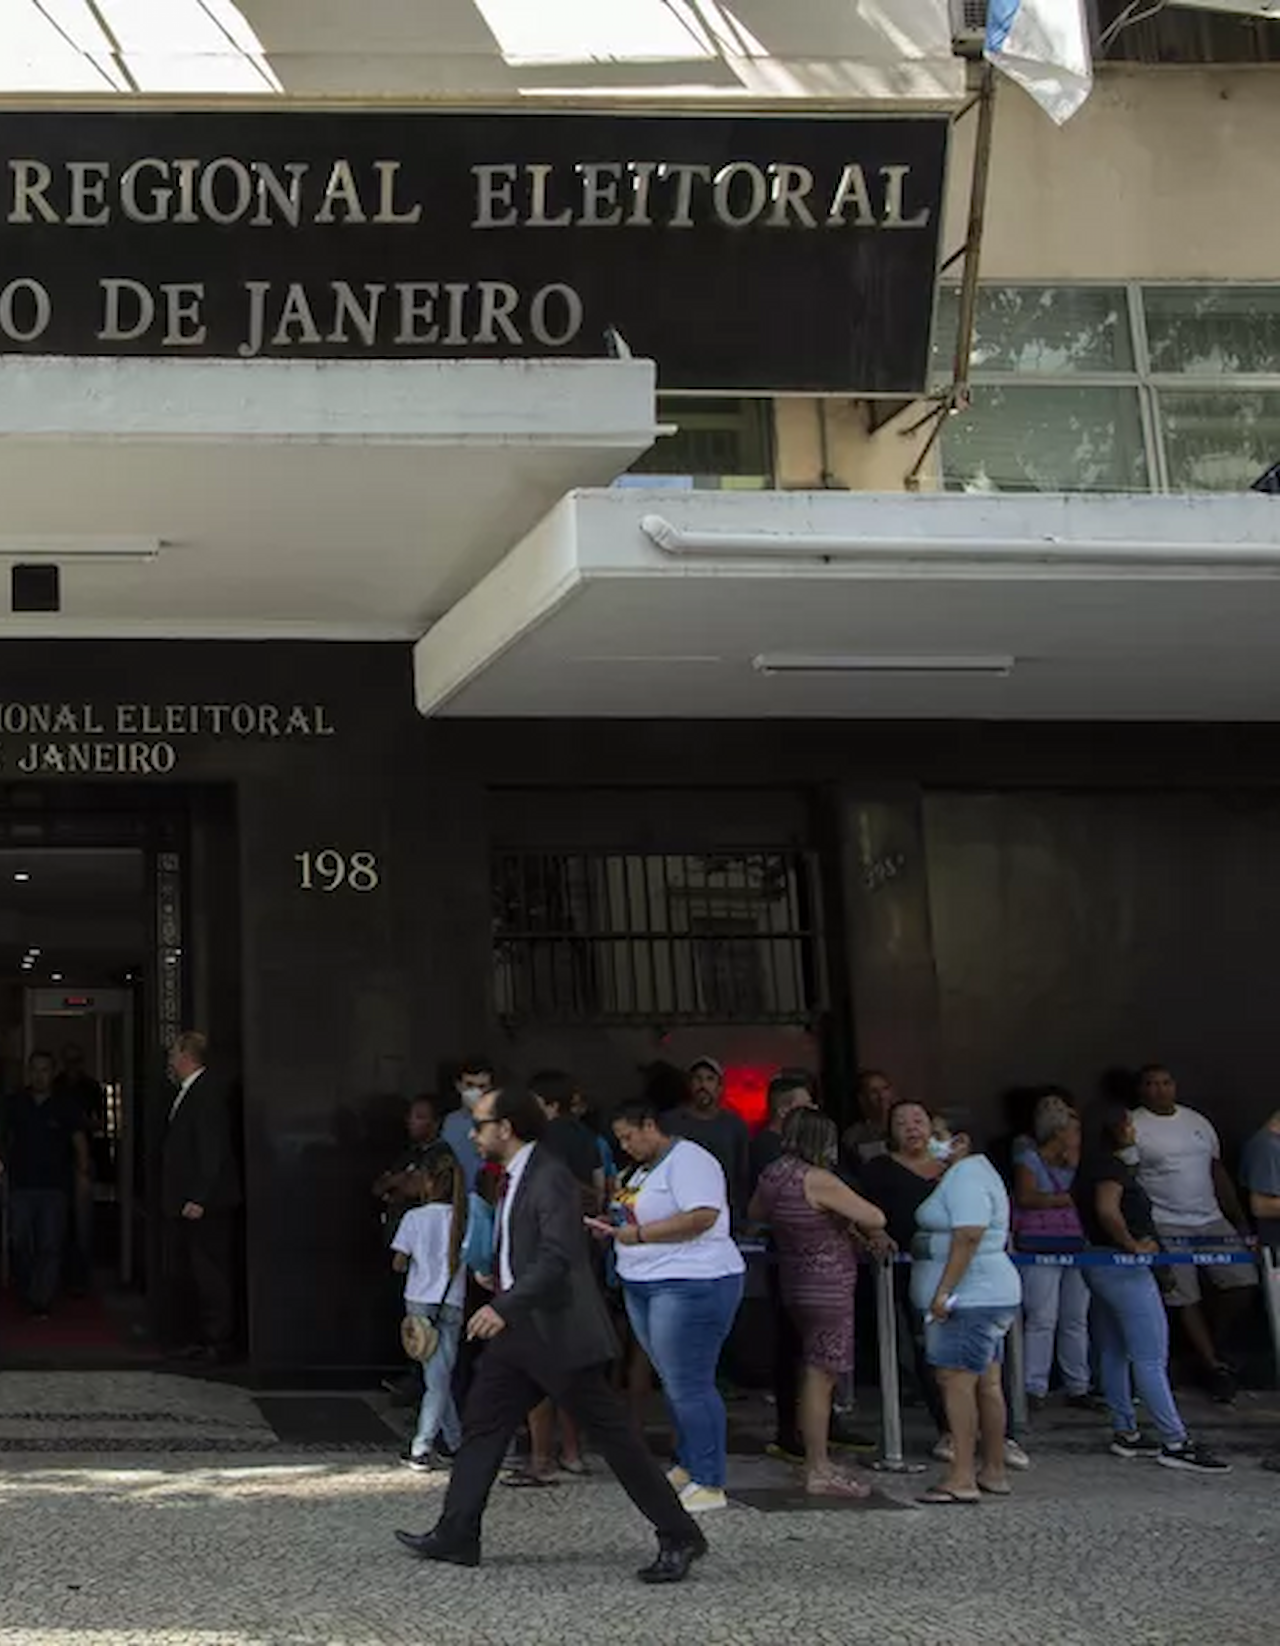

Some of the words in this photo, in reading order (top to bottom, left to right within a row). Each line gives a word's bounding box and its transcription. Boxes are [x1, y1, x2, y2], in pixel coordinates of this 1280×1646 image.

[6, 157, 422, 228] REGIONAL
[469, 160, 931, 228] ELEITORAL
[96, 277, 208, 346] DE
[238, 278, 584, 358] JANEIRO
[116, 703, 336, 736] ELEITORAL
[18, 740, 177, 773] JANEIRO
[294, 848, 379, 892] 198
